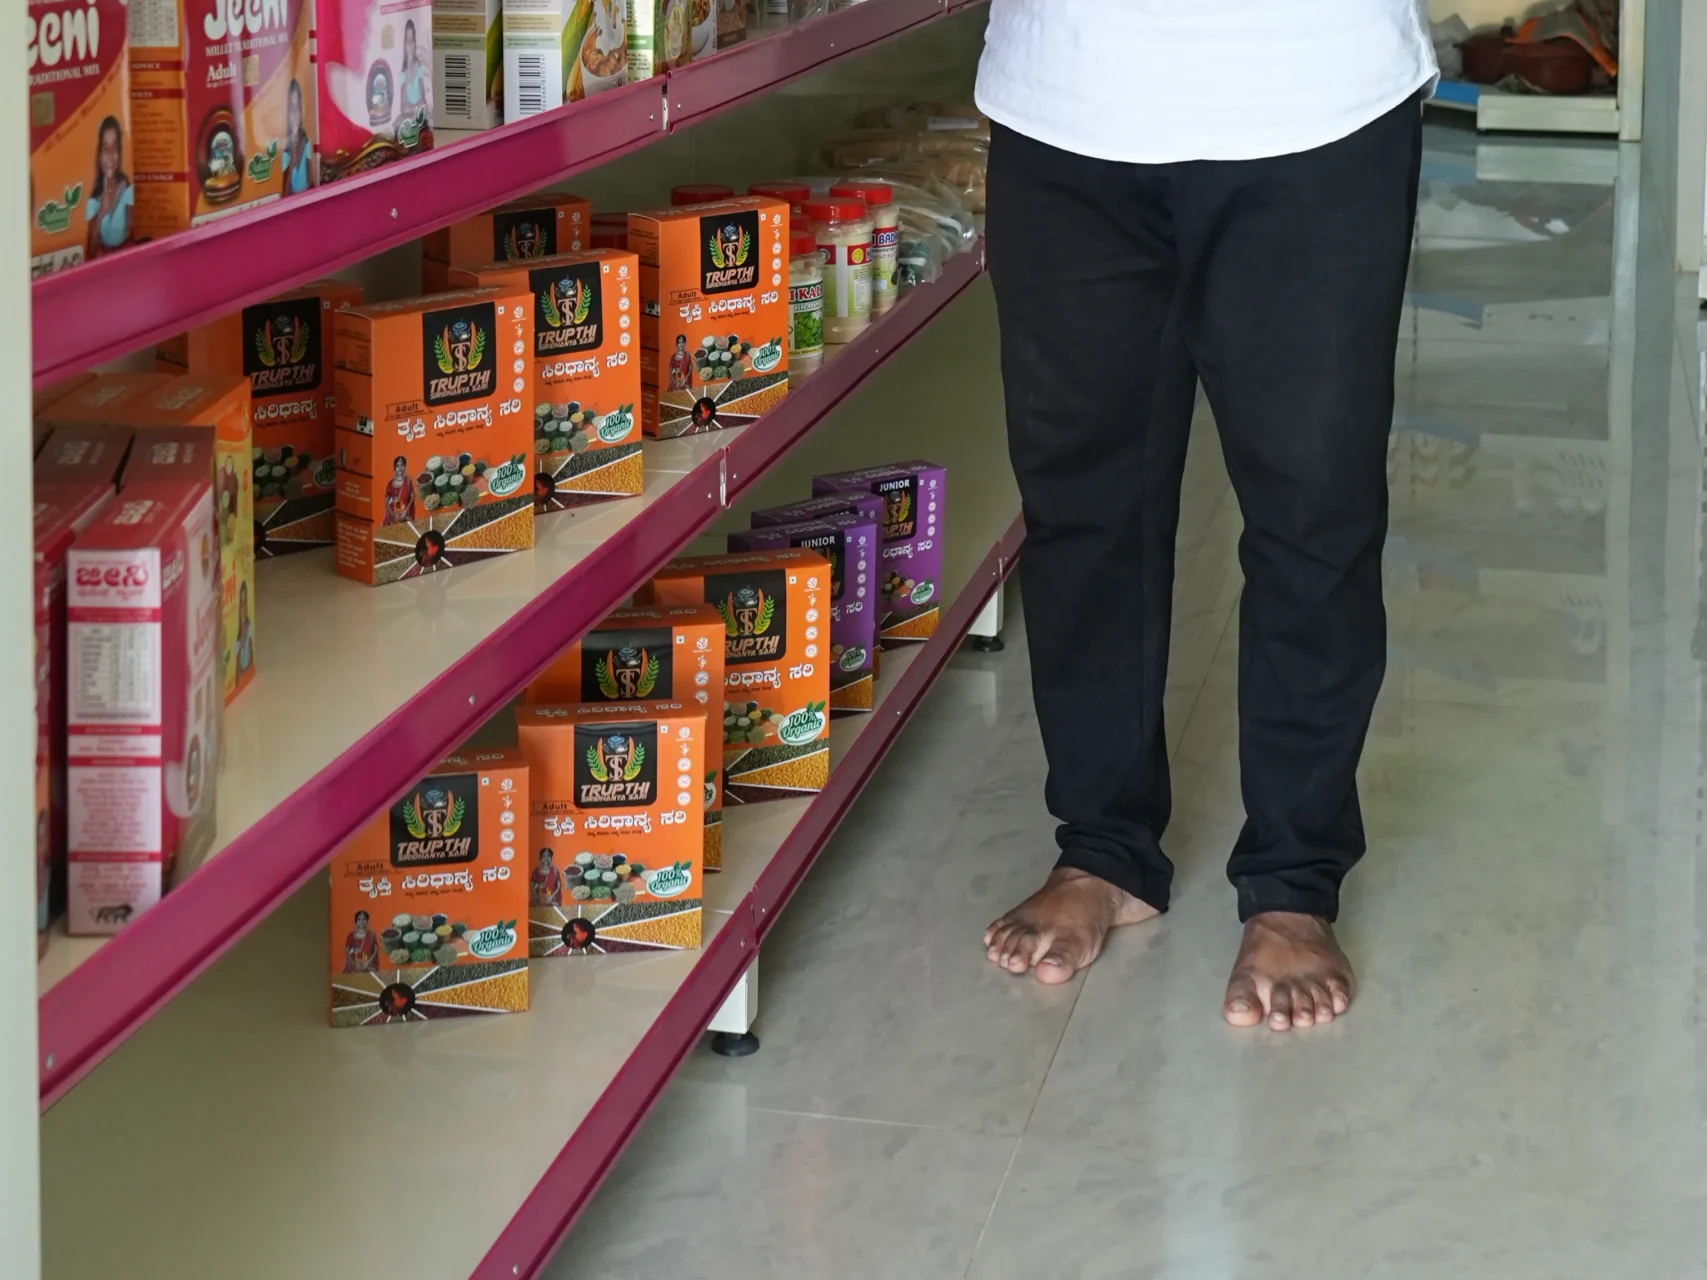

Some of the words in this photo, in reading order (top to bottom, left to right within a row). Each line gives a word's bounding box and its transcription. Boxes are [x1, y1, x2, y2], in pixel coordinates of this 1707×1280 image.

[29, 67, 82, 86] RADITIONAL
[207, 61, 237, 81] Adult
[705, 266, 755, 284] TRUPTHI
[677, 291, 697, 300] Adult
[708, 294, 755, 314] ಸಿರಿಧಾನ್ಯ
[761, 291, 779, 306] ಸರಿ
[538, 324, 597, 345] TRUPTHI
[754, 351, 780, 367] Organic
[758, 344, 777, 358] 100%
[251, 363, 315, 386] TRUPTHI
[542, 356, 600, 379] ಸಿರಿಧಾನ್ಯ
[606, 352, 628, 368] ಸರಿ
[429, 370, 491, 394] TRUPTHI
[430, 387, 470, 399] SIRIDHANYA
[395, 402, 419, 413] Adult
[433, 404, 493, 429] ಸಿರಿಧಾನ್ಯ
[499, 398, 521, 416] ಸರಿ
[604, 411, 627, 427] 100%
[600, 419, 632, 438] Organic
[495, 462, 519, 480] 100%
[490, 469, 523, 492] Organic
[879, 479, 910, 492] JUNIOR
[801, 536, 835, 548] JUNIOR
[725, 635, 780, 653] RUPTHI
[725, 650, 756, 659] DHANYA
[724, 667, 781, 688] ರಿಧಾನ್ಯ
[789, 663, 814, 680] ಸರಿ
[788, 711, 816, 727] 100%
[781, 719, 822, 738] Organic
[580, 782, 650, 798] TRUPTHI
[581, 793, 626, 803] SIRIDHANYA
[542, 803, 568, 811] Adult
[584, 811, 652, 833] ಸಿರಿಧಾನ್ಯ
[660, 810, 687, 825] ಸರಿ
[397, 836, 472, 856] TRUPTHI
[356, 862, 384, 871] Adult
[656, 868, 684, 881] 100%
[402, 869, 474, 891] ಸಿರಿಧಾನ್ಯ
[482, 866, 511, 883] ಸರಿ
[650, 874, 689, 893] Organic
[472, 933, 514, 952] Organic
[479, 926, 508, 943] 100%
